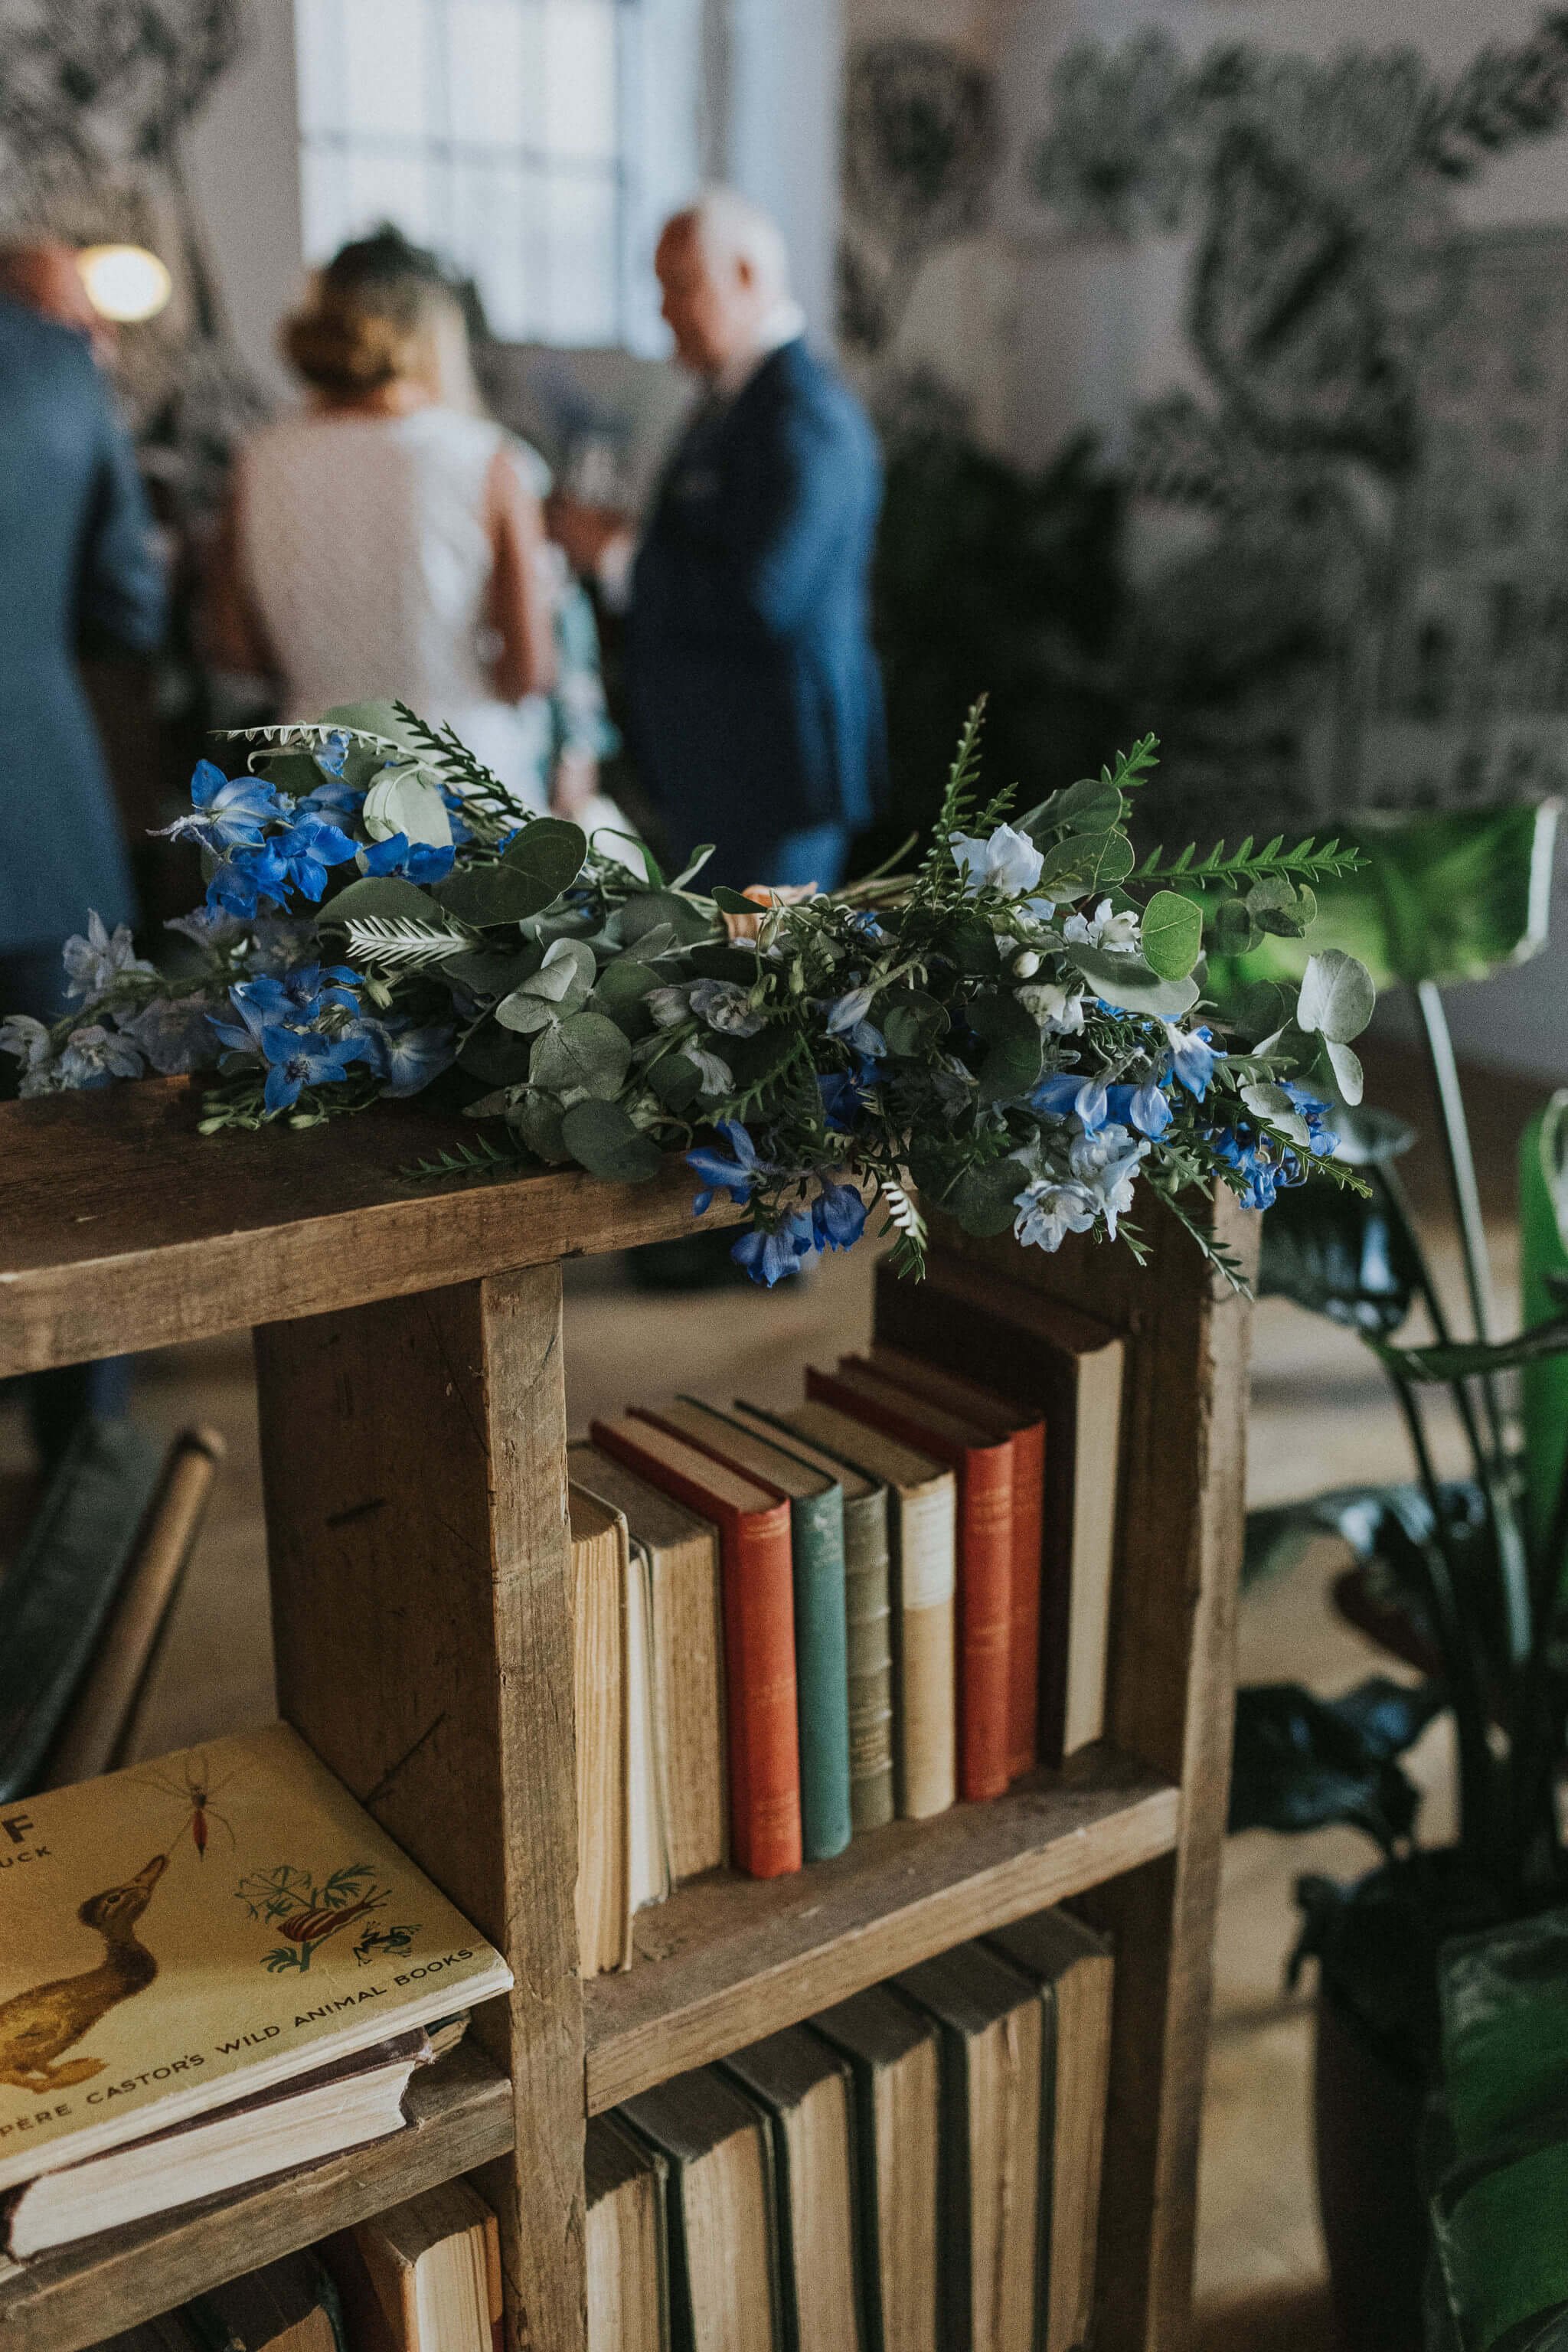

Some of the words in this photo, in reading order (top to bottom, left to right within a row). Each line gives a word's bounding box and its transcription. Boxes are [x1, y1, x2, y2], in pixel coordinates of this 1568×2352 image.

[86, 2054, 205, 2104] CASTOR'S
[215, 2025, 281, 2055] WILD
[294, 1986, 387, 2027] ANIMAL
[394, 1949, 474, 1986] BOOKS
